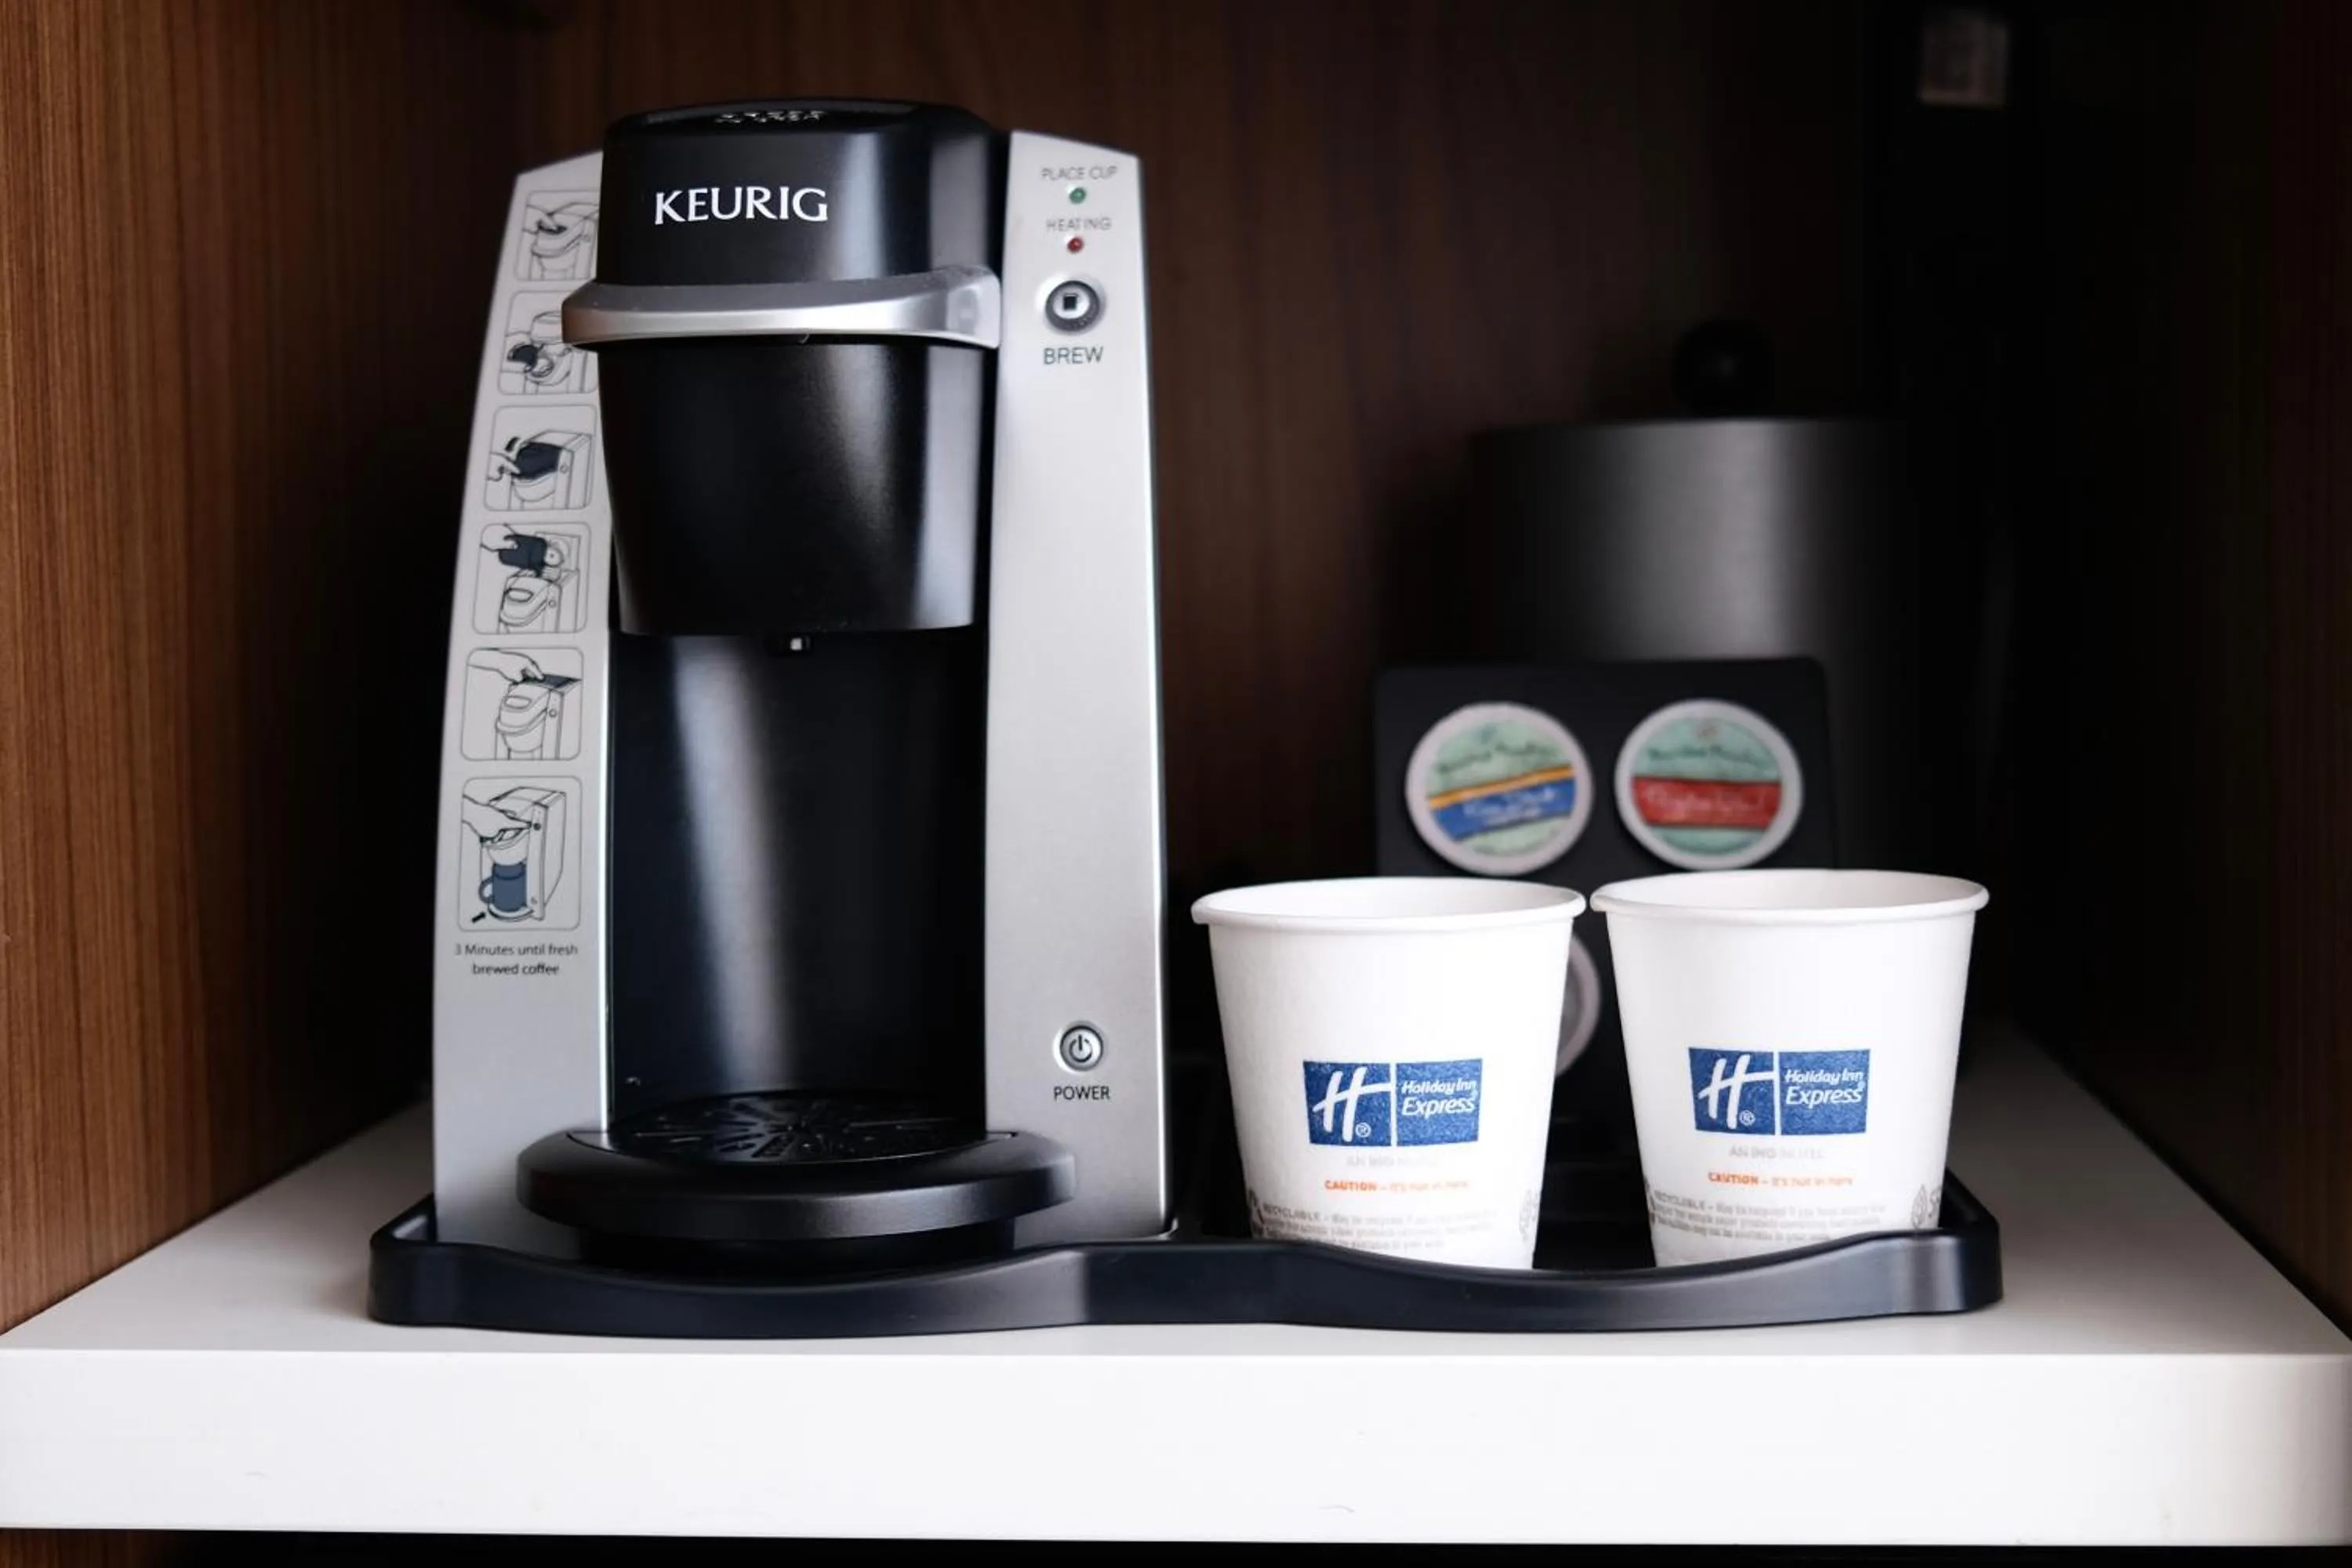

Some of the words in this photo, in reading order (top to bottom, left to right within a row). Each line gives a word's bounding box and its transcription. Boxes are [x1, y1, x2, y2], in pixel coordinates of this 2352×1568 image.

[1041, 167, 1086, 181] PLACE
[1088, 165, 1118, 180] CUP
[654, 186, 829, 225] KEURIG
[1046, 217, 1112, 231] HEATING
[1043, 347, 1104, 365] BREW
[455, 943, 462, 956] 3
[465, 944, 514, 956] Minutes
[518, 943, 545, 956] until
[548, 943, 579, 956] fresh
[472, 963, 519, 975] brewed
[1785, 1069, 1840, 1084] Holiday
[1842, 1069, 1864, 1082] Inn
[1054, 1085, 1110, 1101] POWER
[1401, 1080, 1455, 1096] Holiday
[1456, 1078, 1477, 1091] Inn
[1324, 1179, 1377, 1192] CAUTION
[1708, 1171, 1759, 1185] CAUTION
